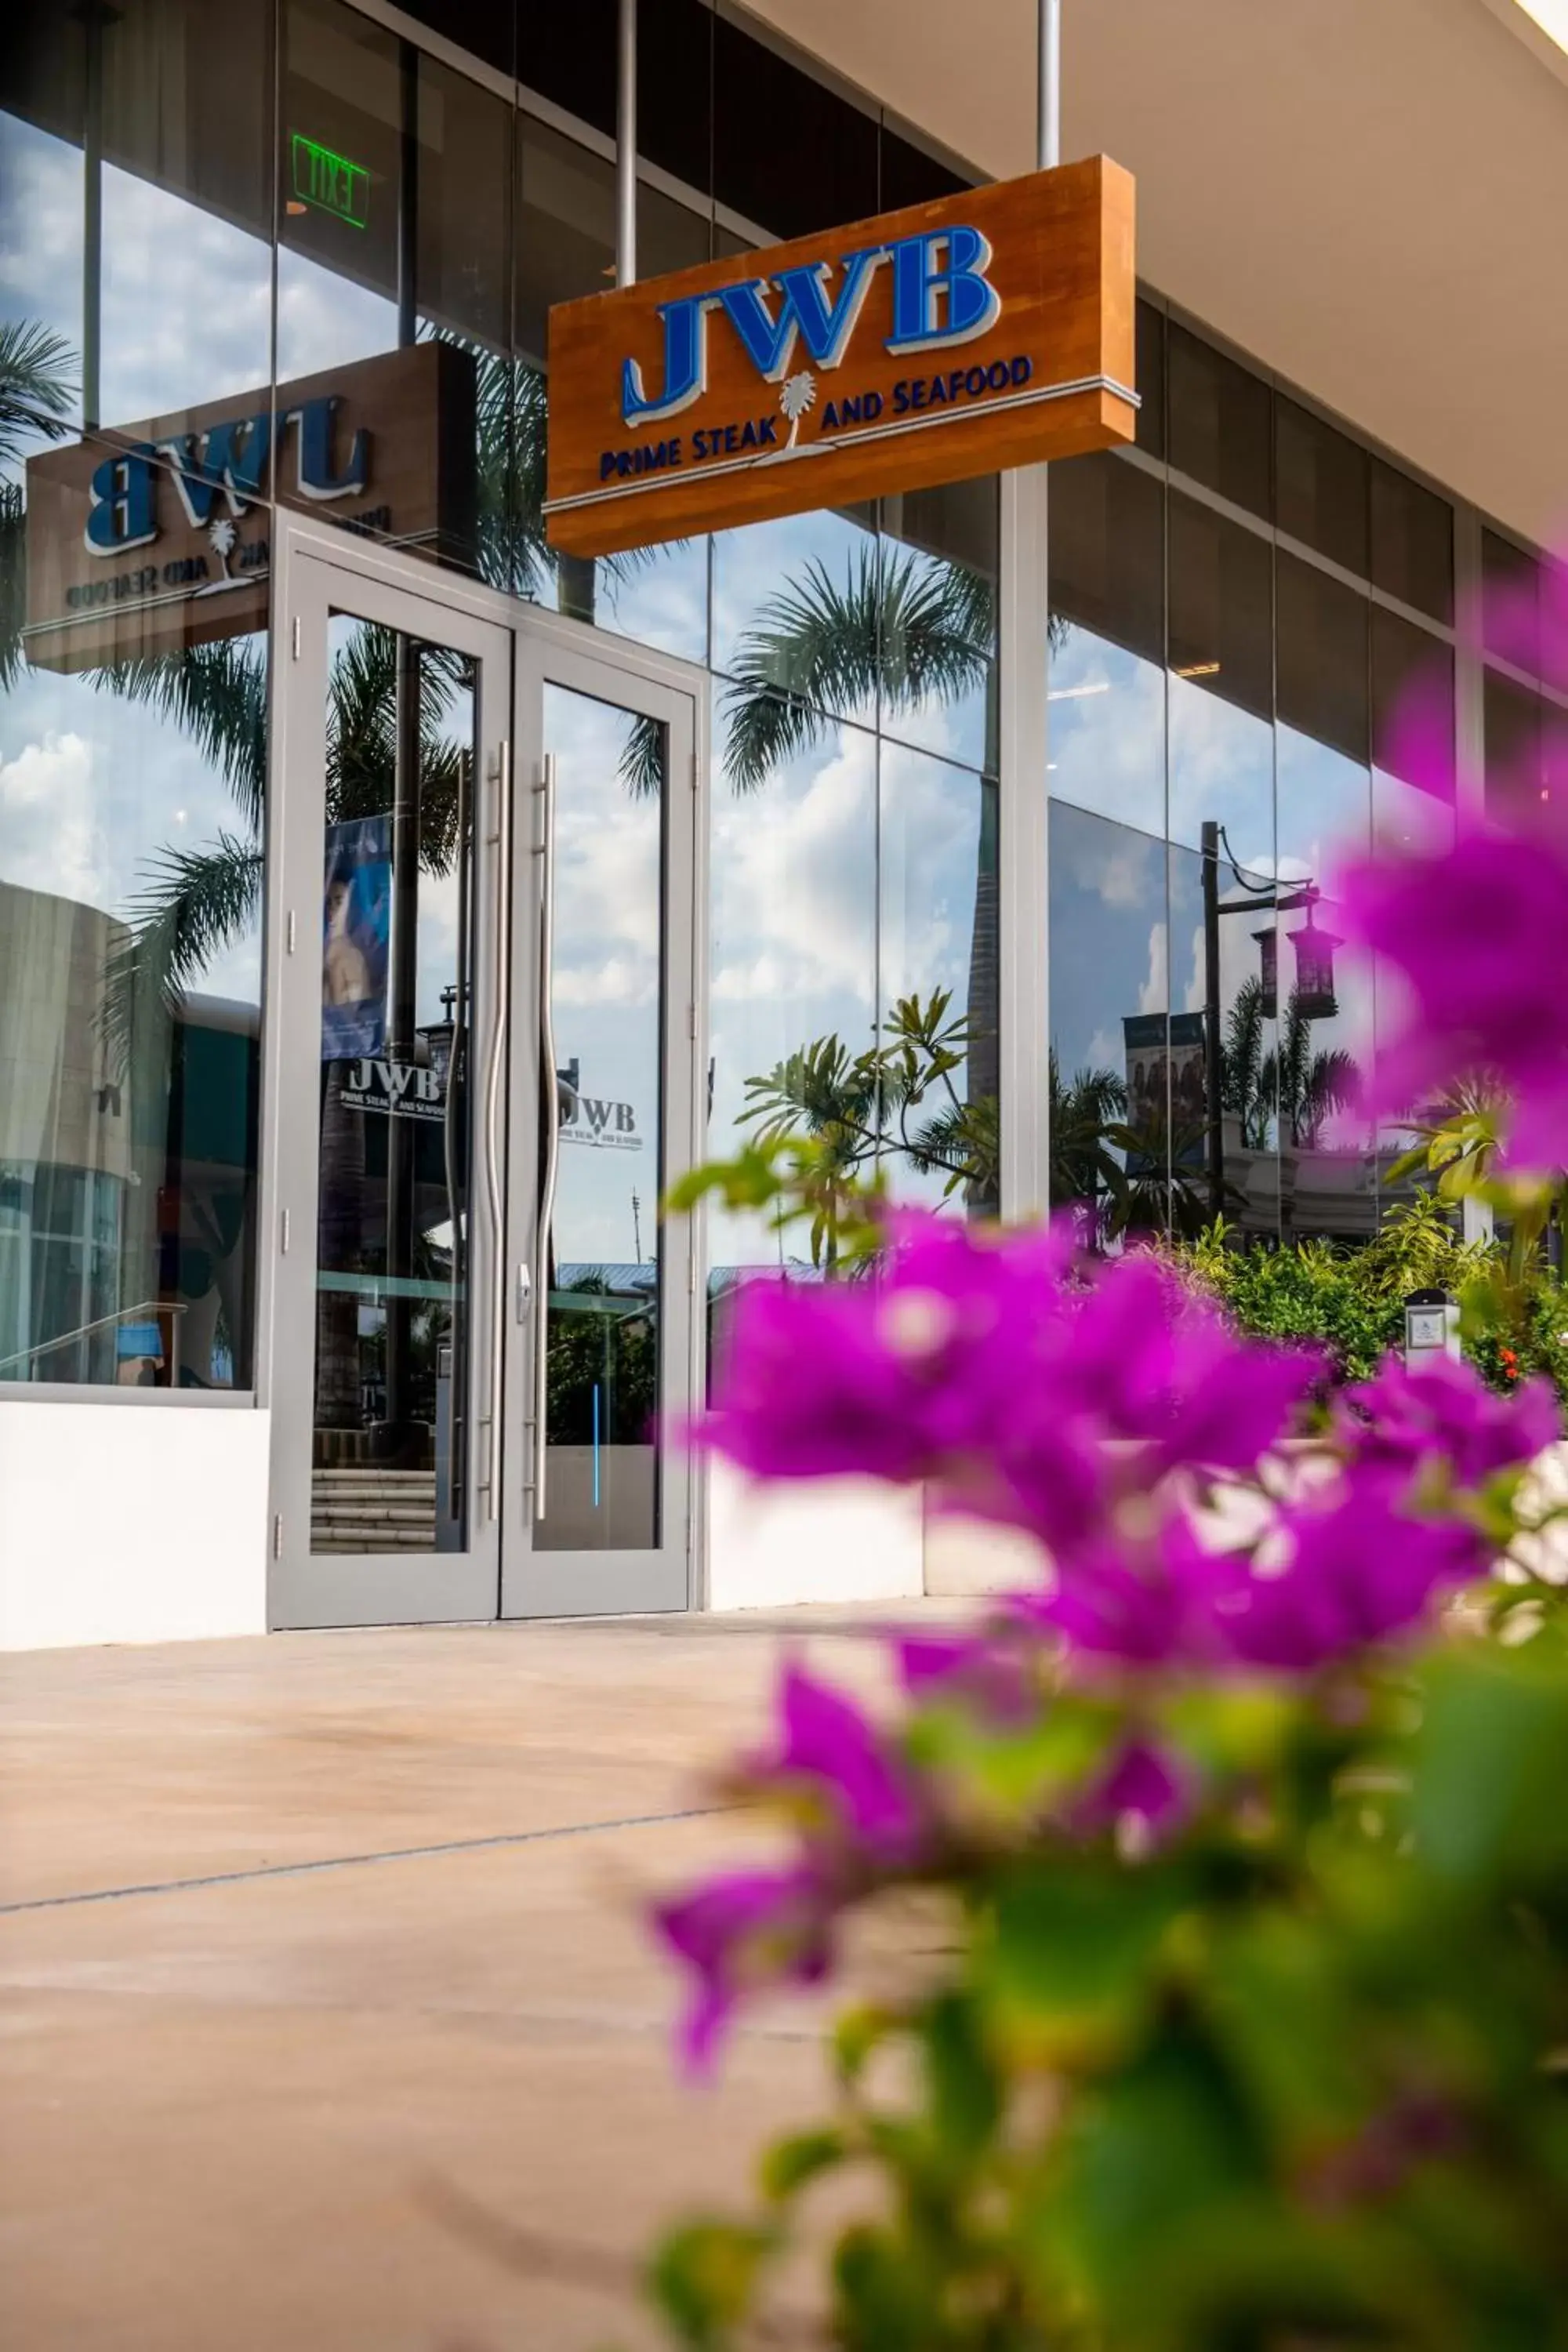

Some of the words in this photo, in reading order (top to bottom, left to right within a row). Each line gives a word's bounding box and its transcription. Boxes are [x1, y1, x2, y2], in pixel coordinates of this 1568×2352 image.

[621, 224, 1002, 427] JWB
[600, 437, 682, 481] PRIME
[691, 415, 779, 461] STEAK
[821, 391, 884, 430] AND
[892, 355, 1033, 414] SEAFOOD
[350, 1058, 440, 1102] JWB
